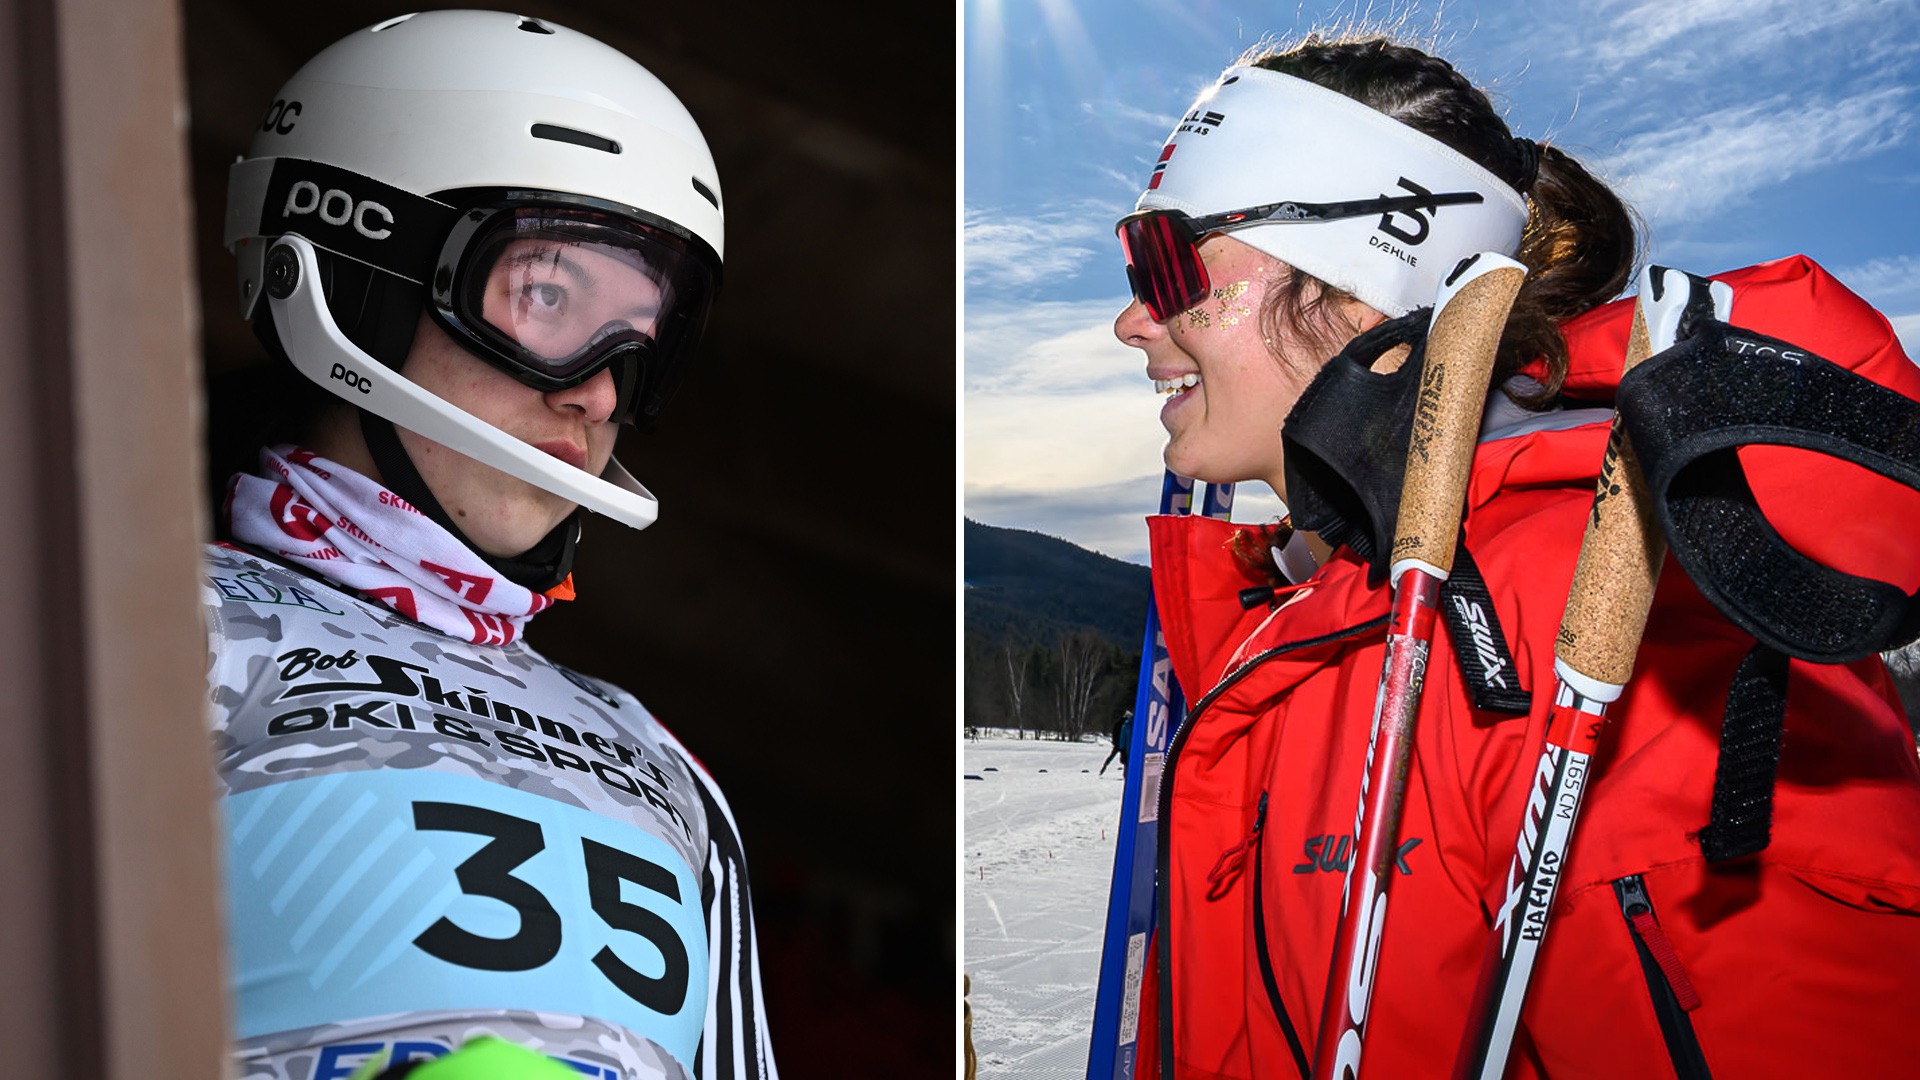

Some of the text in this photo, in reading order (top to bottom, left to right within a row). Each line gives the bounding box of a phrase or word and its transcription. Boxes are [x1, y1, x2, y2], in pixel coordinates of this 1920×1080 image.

[276, 647, 360, 682] Bob
[433, 712, 491, 747] &
[1555, 756, 1586, 821] 165 CM
[411, 801, 690, 1016] 35
